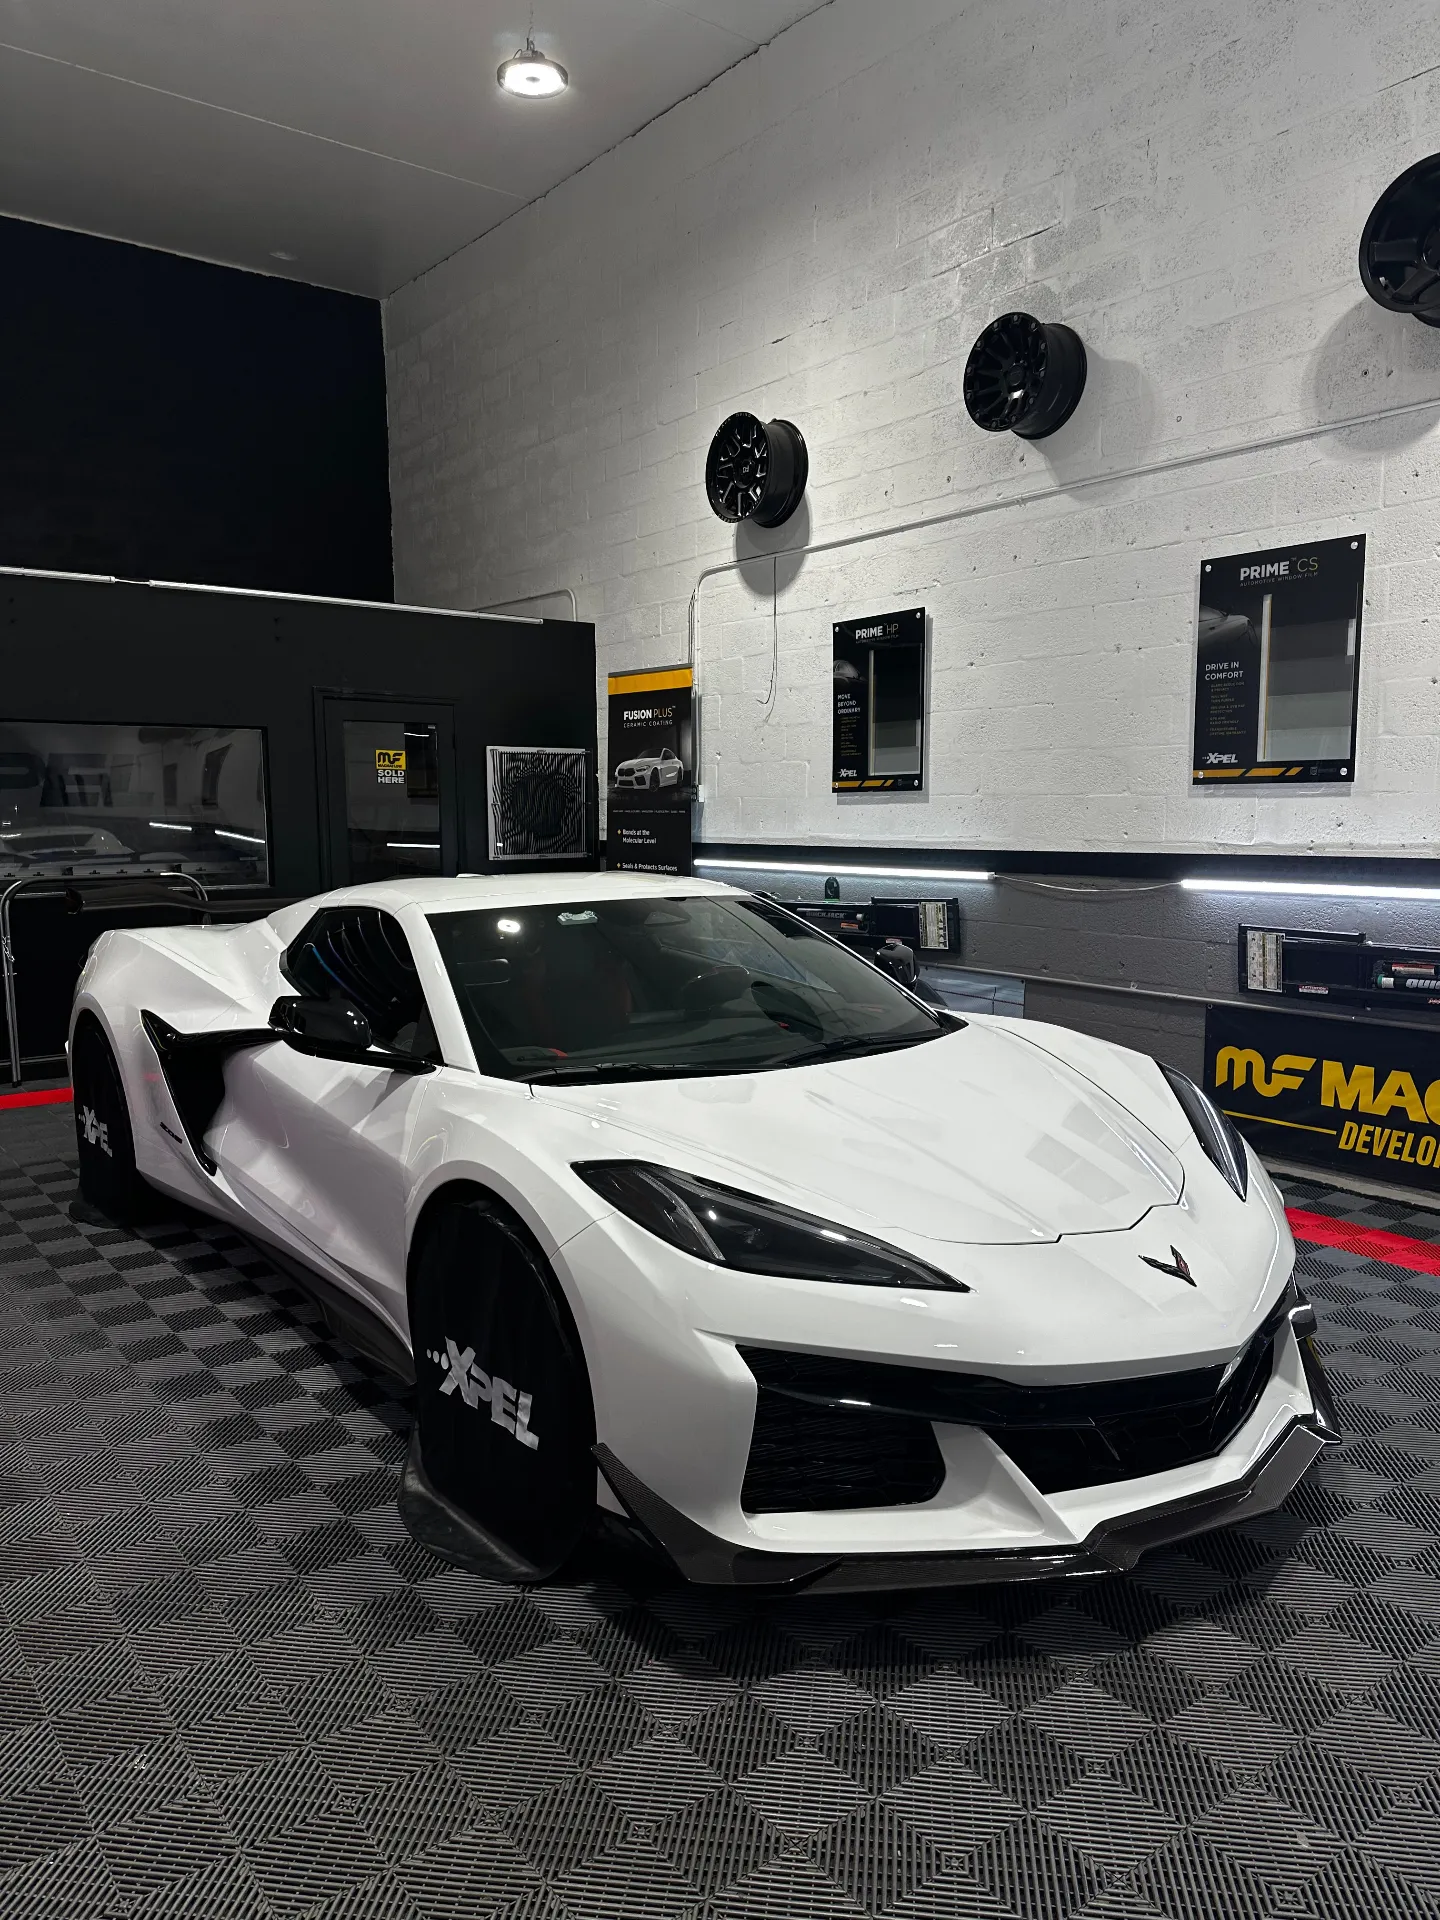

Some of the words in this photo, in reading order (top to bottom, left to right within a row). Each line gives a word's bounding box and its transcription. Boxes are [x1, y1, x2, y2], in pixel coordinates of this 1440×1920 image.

[1240, 561, 1290, 580] PRIME
[1297, 557, 1318, 572] CS
[1240, 578, 1275, 587] AUTOMOTIVE
[1278, 574, 1303, 582] WINDOW
[856, 626, 883, 639] PRIME
[886, 624, 899, 634] HP
[1205, 662, 1229, 671] DRIVE
[1231, 661, 1240, 669] IN
[1205, 671, 1243, 680] COMFORT
[623, 709, 652, 720] FUSION
[653, 707, 673, 718] PLUS
[1206, 752, 1239, 764] XPEL
[839, 769, 858, 777] XPEL
[658, 864, 678, 872] Surfaces
[82, 1105, 113, 1157] XPEL
[438, 1335, 540, 1451] XPEL
